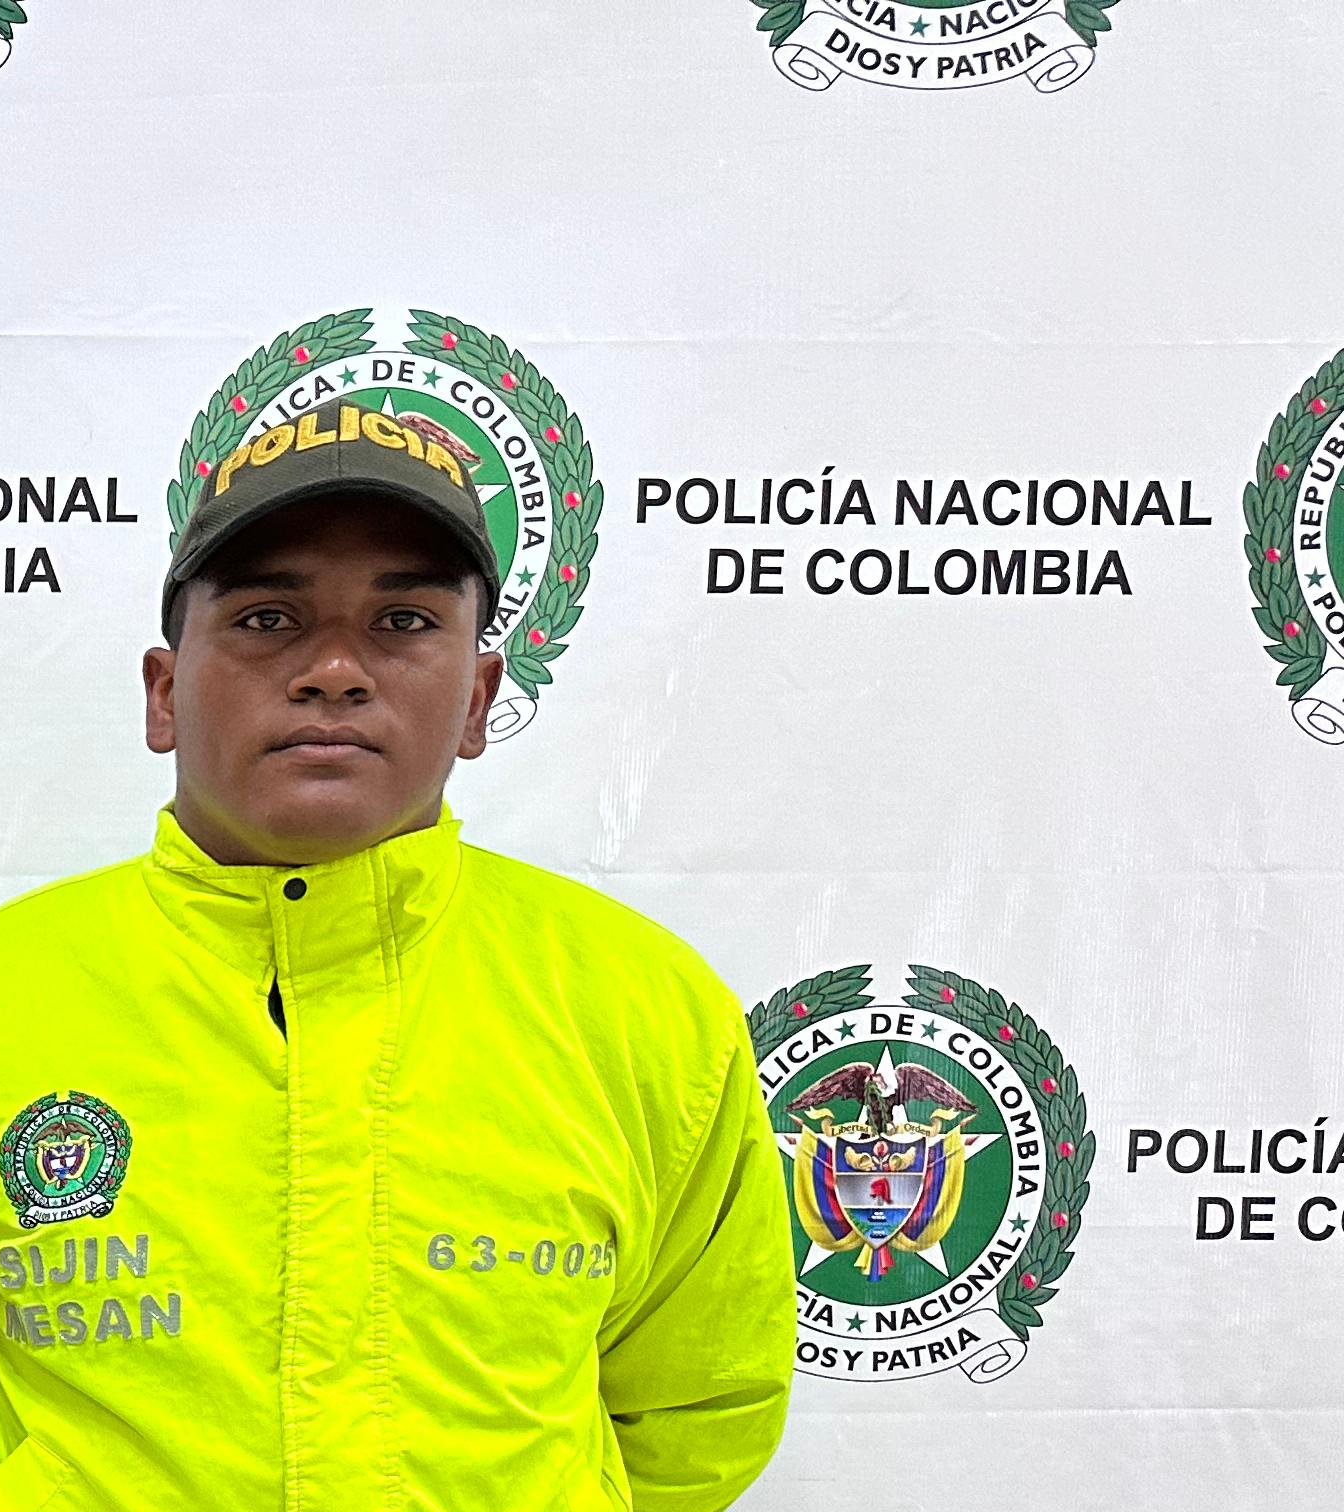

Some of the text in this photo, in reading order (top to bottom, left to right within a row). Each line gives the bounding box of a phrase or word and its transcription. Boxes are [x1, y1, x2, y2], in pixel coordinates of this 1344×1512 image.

[937, 31, 1048, 79] PATRIA
[215, 405, 465, 497] POLICIA
[372, 359, 416, 383] DE
[450, 380, 546, 550] COLOMBIA
[636, 465, 1212, 526] POLICÍA NACIONAL
[706, 548, 1133, 596] DE COLOMBIA
[870, 1013, 914, 1036] DE
[947, 1032, 1040, 1199] COLOMBIA
[1196, 1196, 1276, 1241] DE
[875, 1235, 1021, 1333] NACIONAL
[872, 1326, 982, 1372] PATRIA
